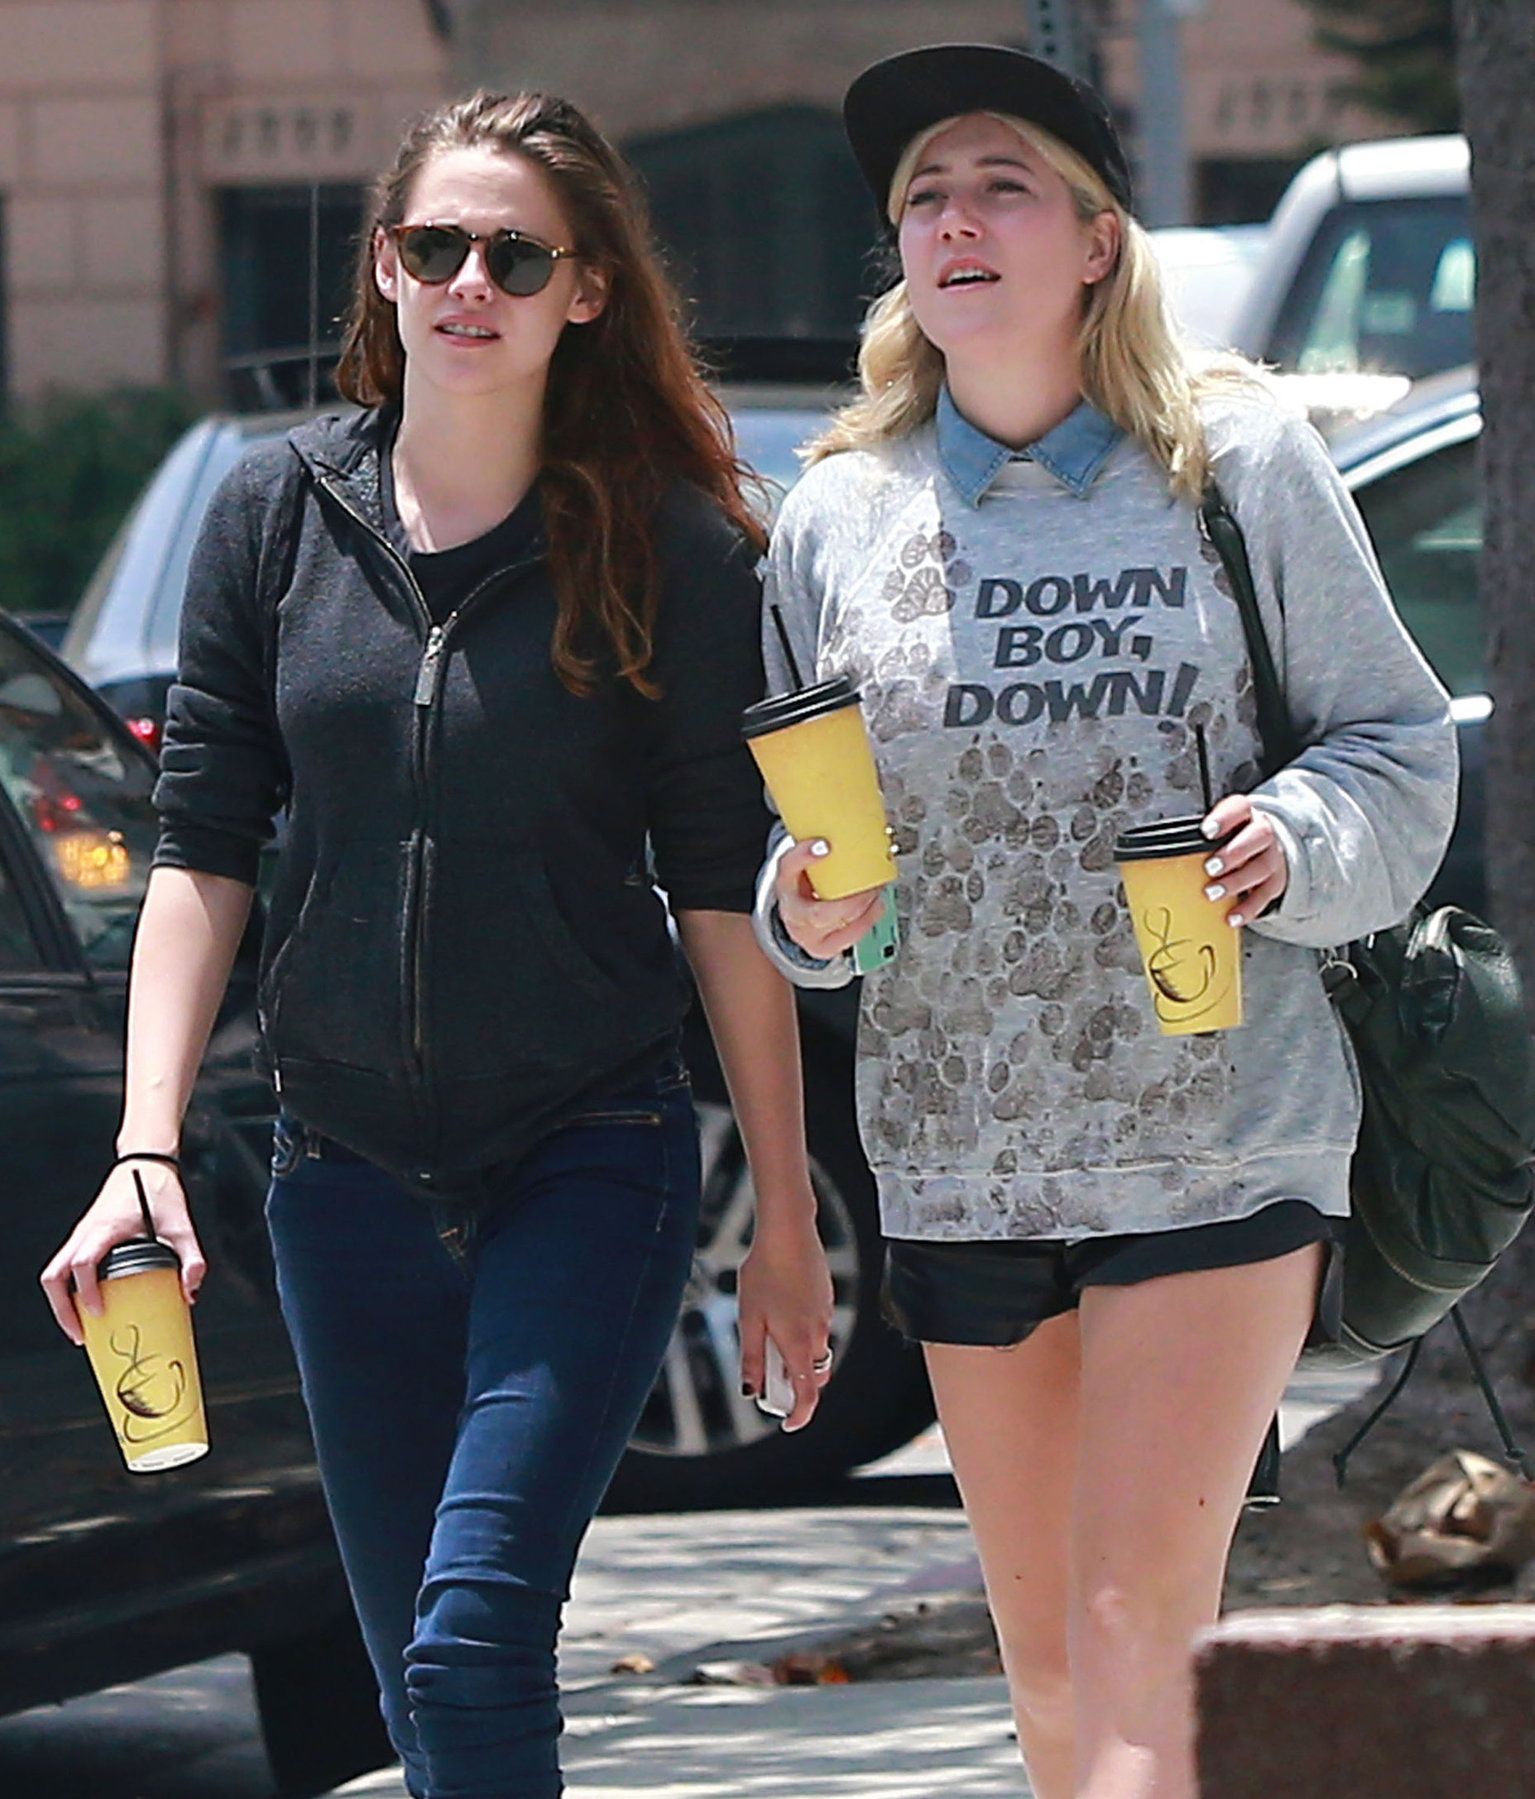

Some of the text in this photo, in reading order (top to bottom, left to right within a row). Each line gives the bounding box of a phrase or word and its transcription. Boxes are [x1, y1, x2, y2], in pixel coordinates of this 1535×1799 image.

[974, 566, 1188, 619] DOWN
[994, 615, 1153, 668] BOY,
[943, 662, 1200, 731] DOWN!
